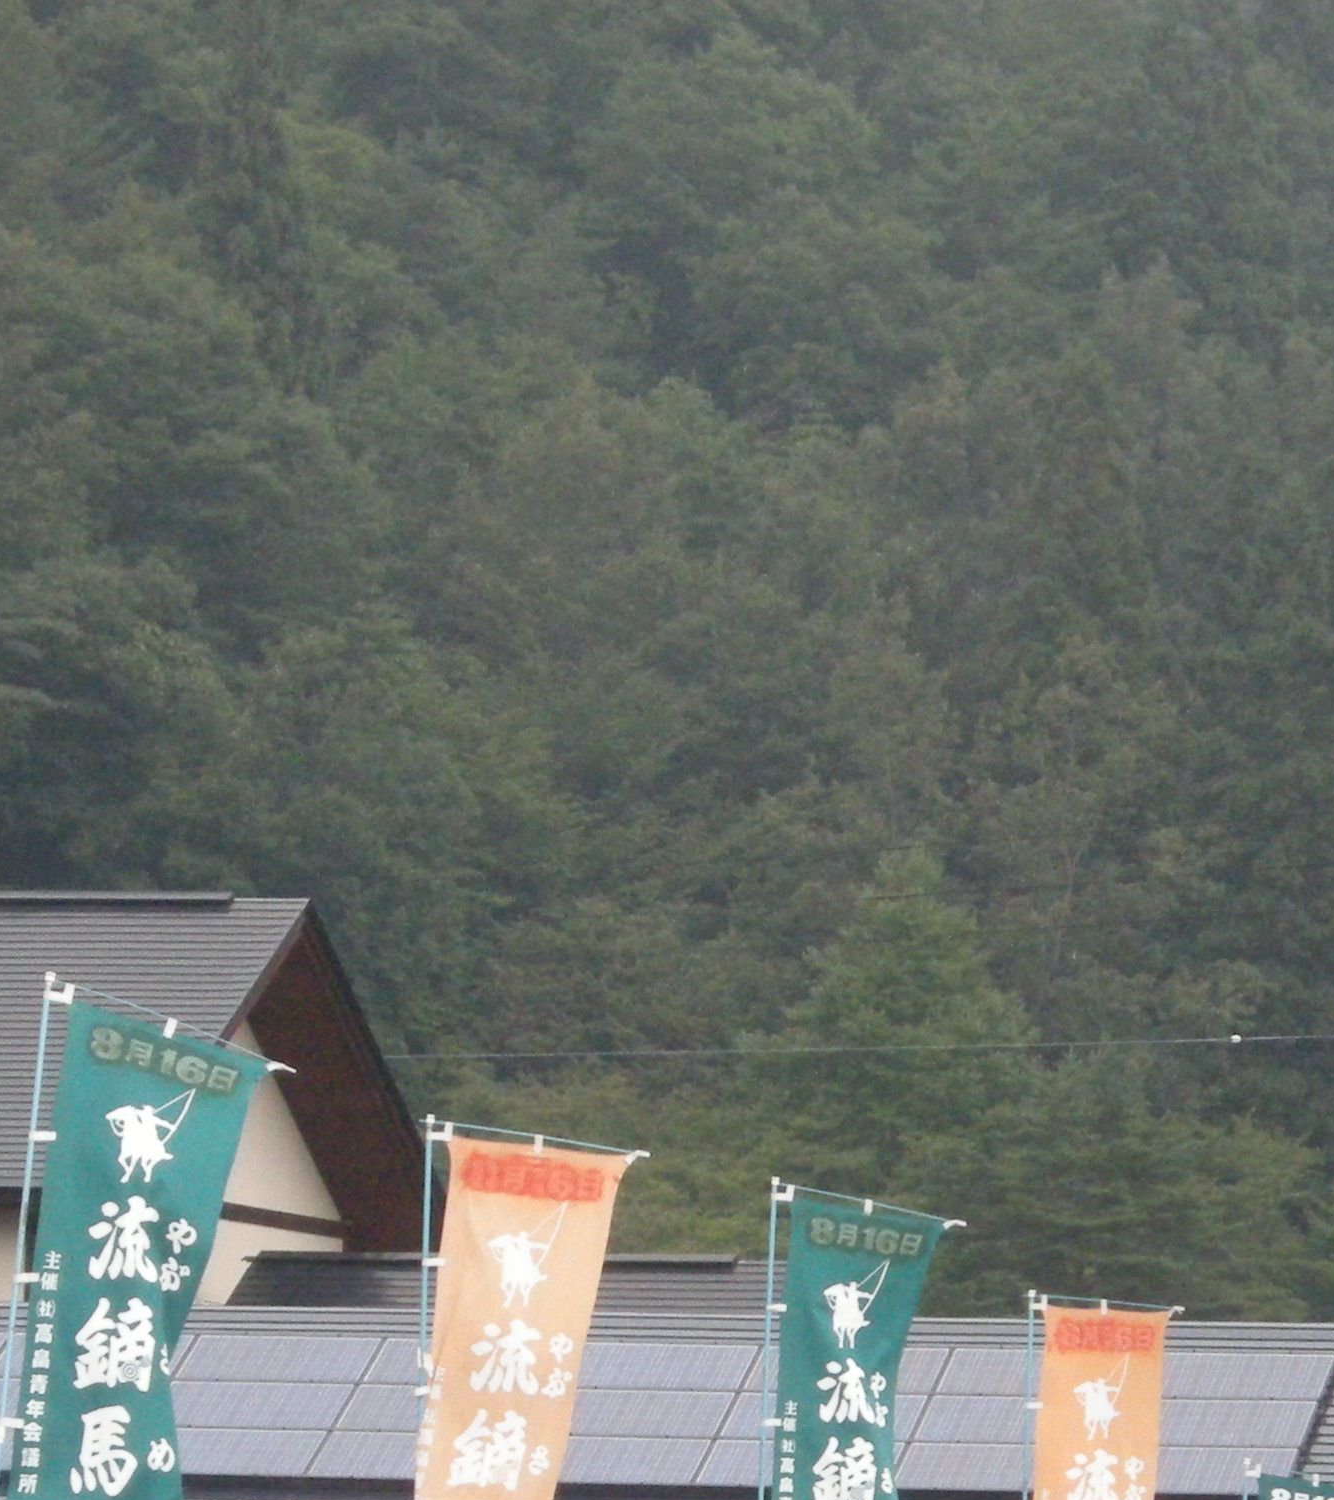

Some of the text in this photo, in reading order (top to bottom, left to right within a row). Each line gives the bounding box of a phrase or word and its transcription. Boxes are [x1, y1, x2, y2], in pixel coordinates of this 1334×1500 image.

[89, 1024, 239, 1094] 8月16日
[810, 1216, 923, 1257] 8月16日
[70, 1196, 159, 1498] 流鏑馬
